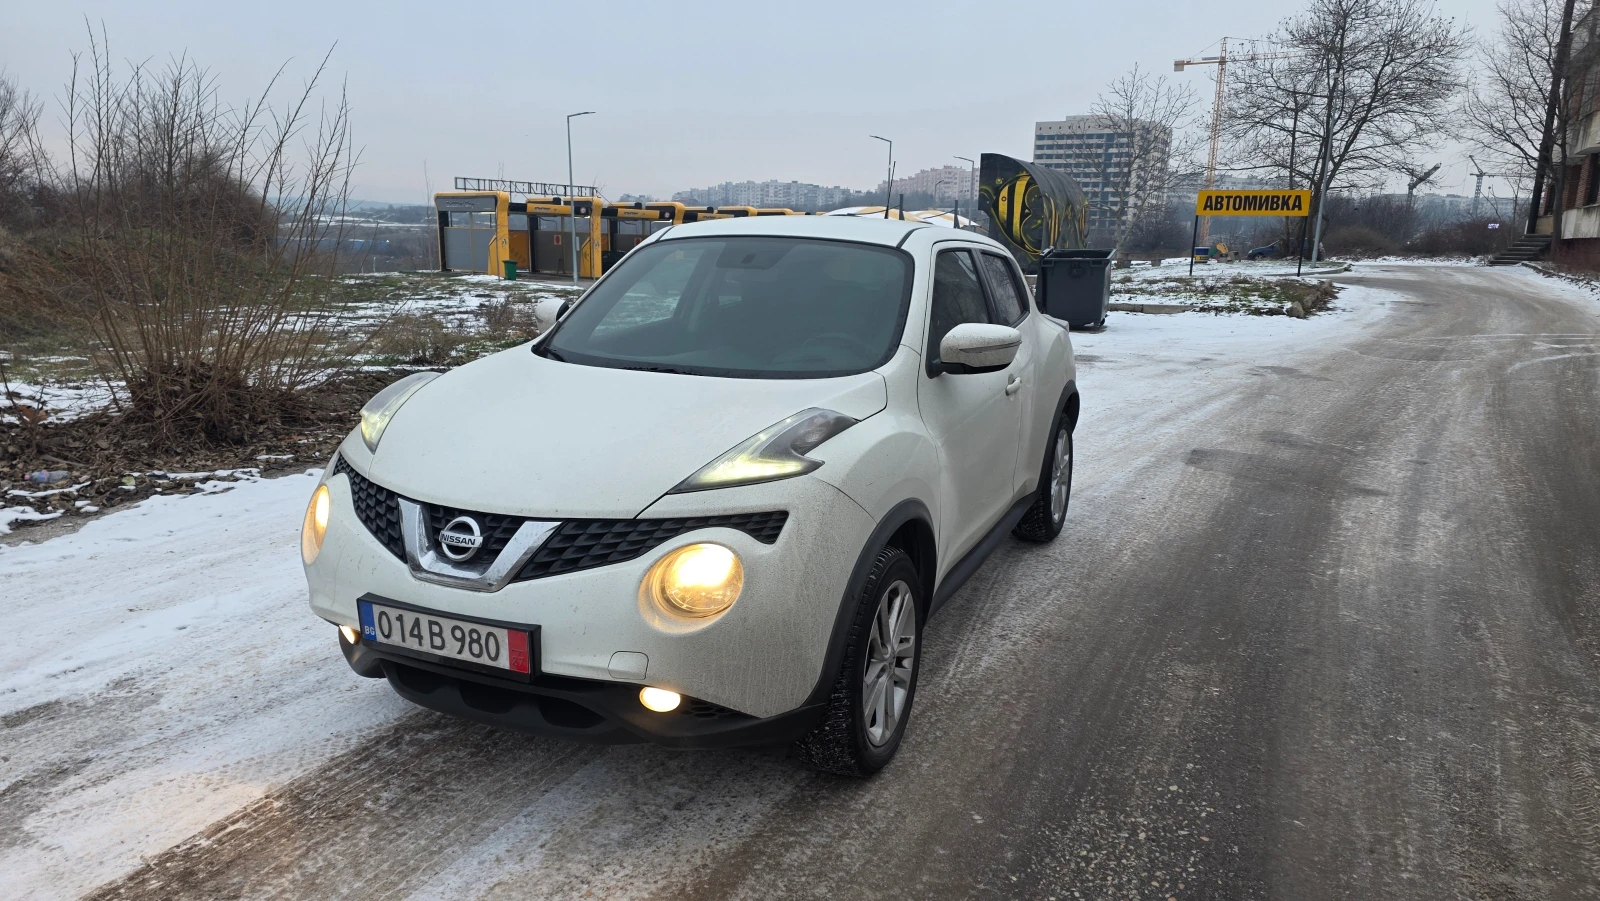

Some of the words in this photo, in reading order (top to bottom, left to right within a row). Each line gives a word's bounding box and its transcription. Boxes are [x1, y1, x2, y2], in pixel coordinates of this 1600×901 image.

[1203, 195, 1302, 211] АВТОМИВКА
[441, 533, 476, 546] NISSAN
[364, 625, 375, 636] BG
